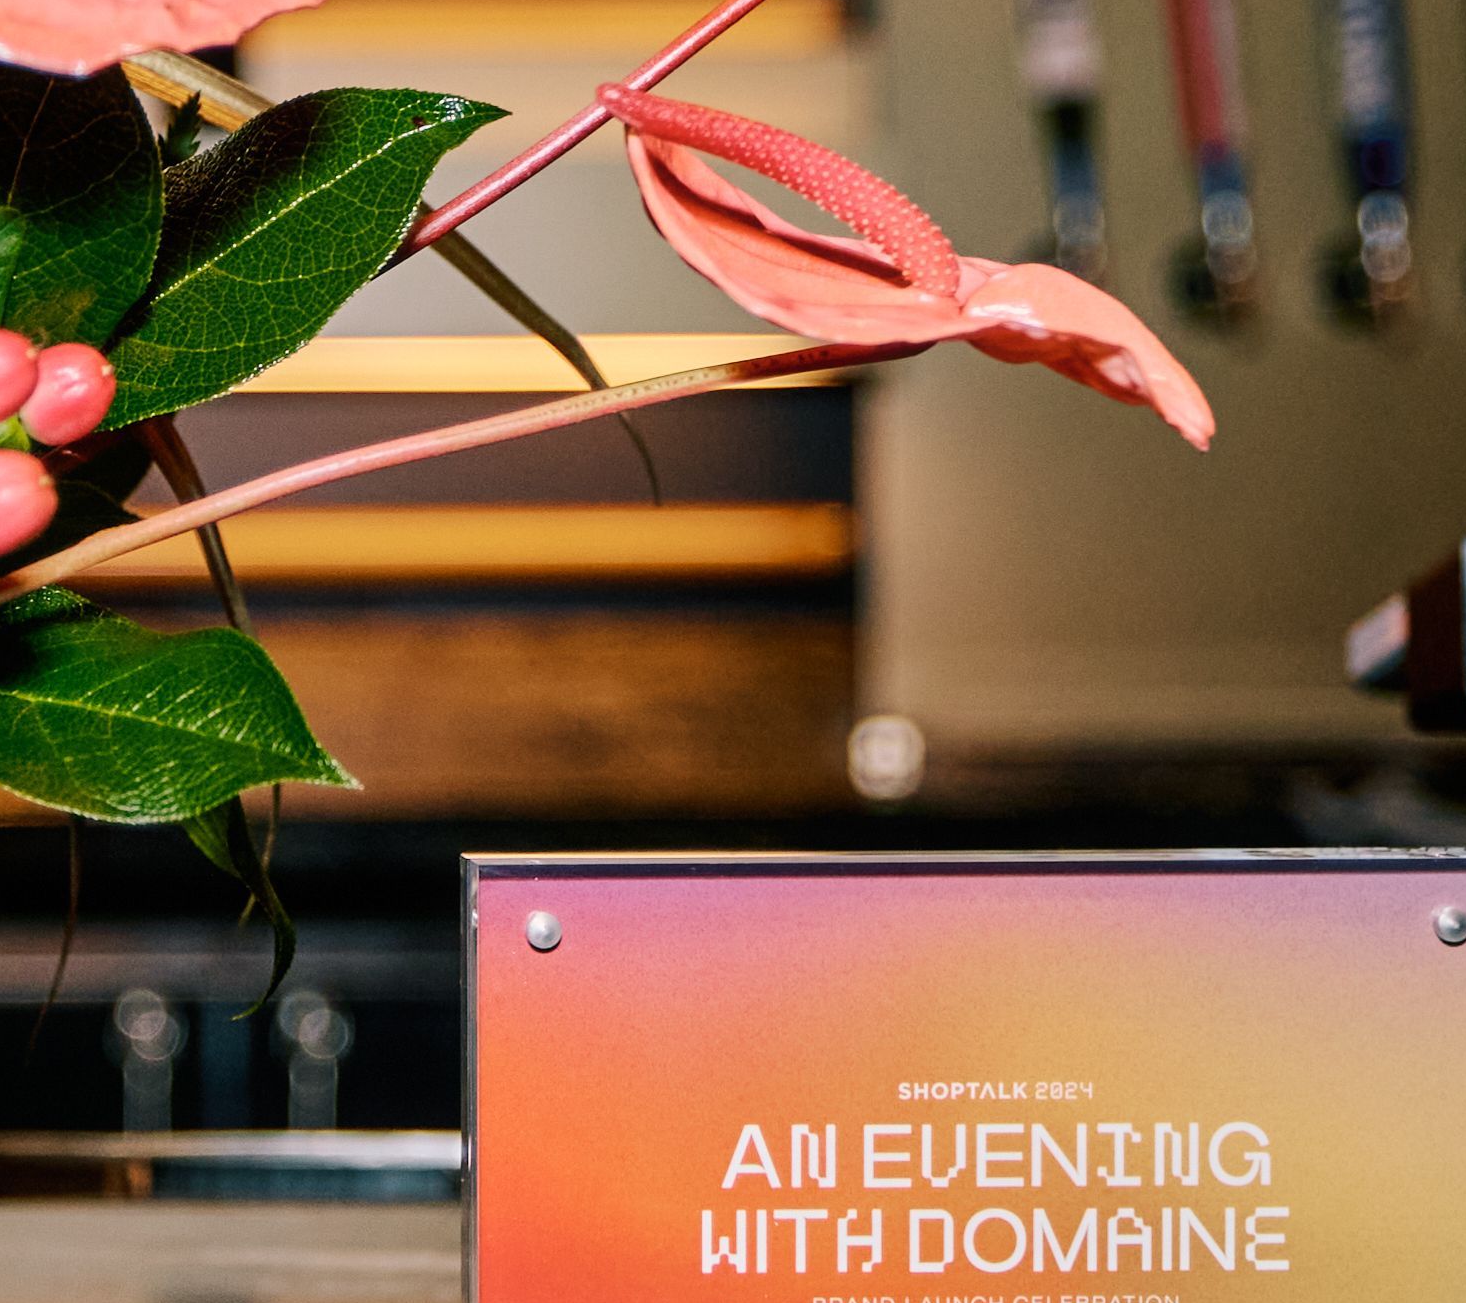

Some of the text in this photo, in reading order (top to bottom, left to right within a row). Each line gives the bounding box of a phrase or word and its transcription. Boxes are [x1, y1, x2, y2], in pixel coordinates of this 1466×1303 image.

[898, 1082, 1094, 1100] SHOPTALK 2024
[721, 1121, 1271, 1190] AN EVENING
[701, 1206, 1290, 1274] WITH DOMAINE
